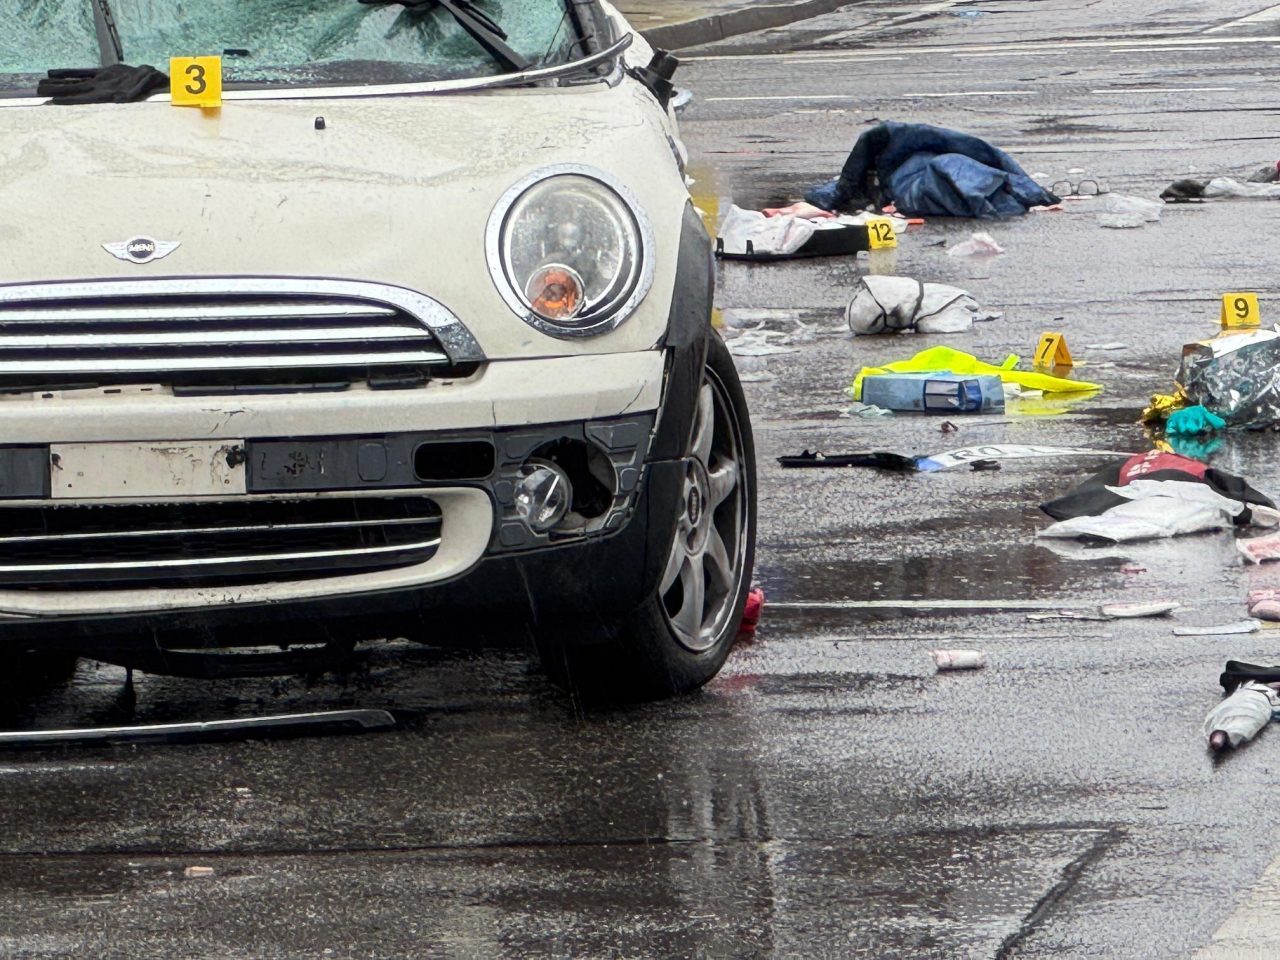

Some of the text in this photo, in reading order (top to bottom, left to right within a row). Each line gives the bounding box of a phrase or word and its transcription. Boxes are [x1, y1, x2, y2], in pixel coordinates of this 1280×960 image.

[185, 64, 207, 95] 3
[871, 224, 894, 241] 12
[1234, 299, 1249, 317] 9
[1041, 338, 1054, 358] 7
